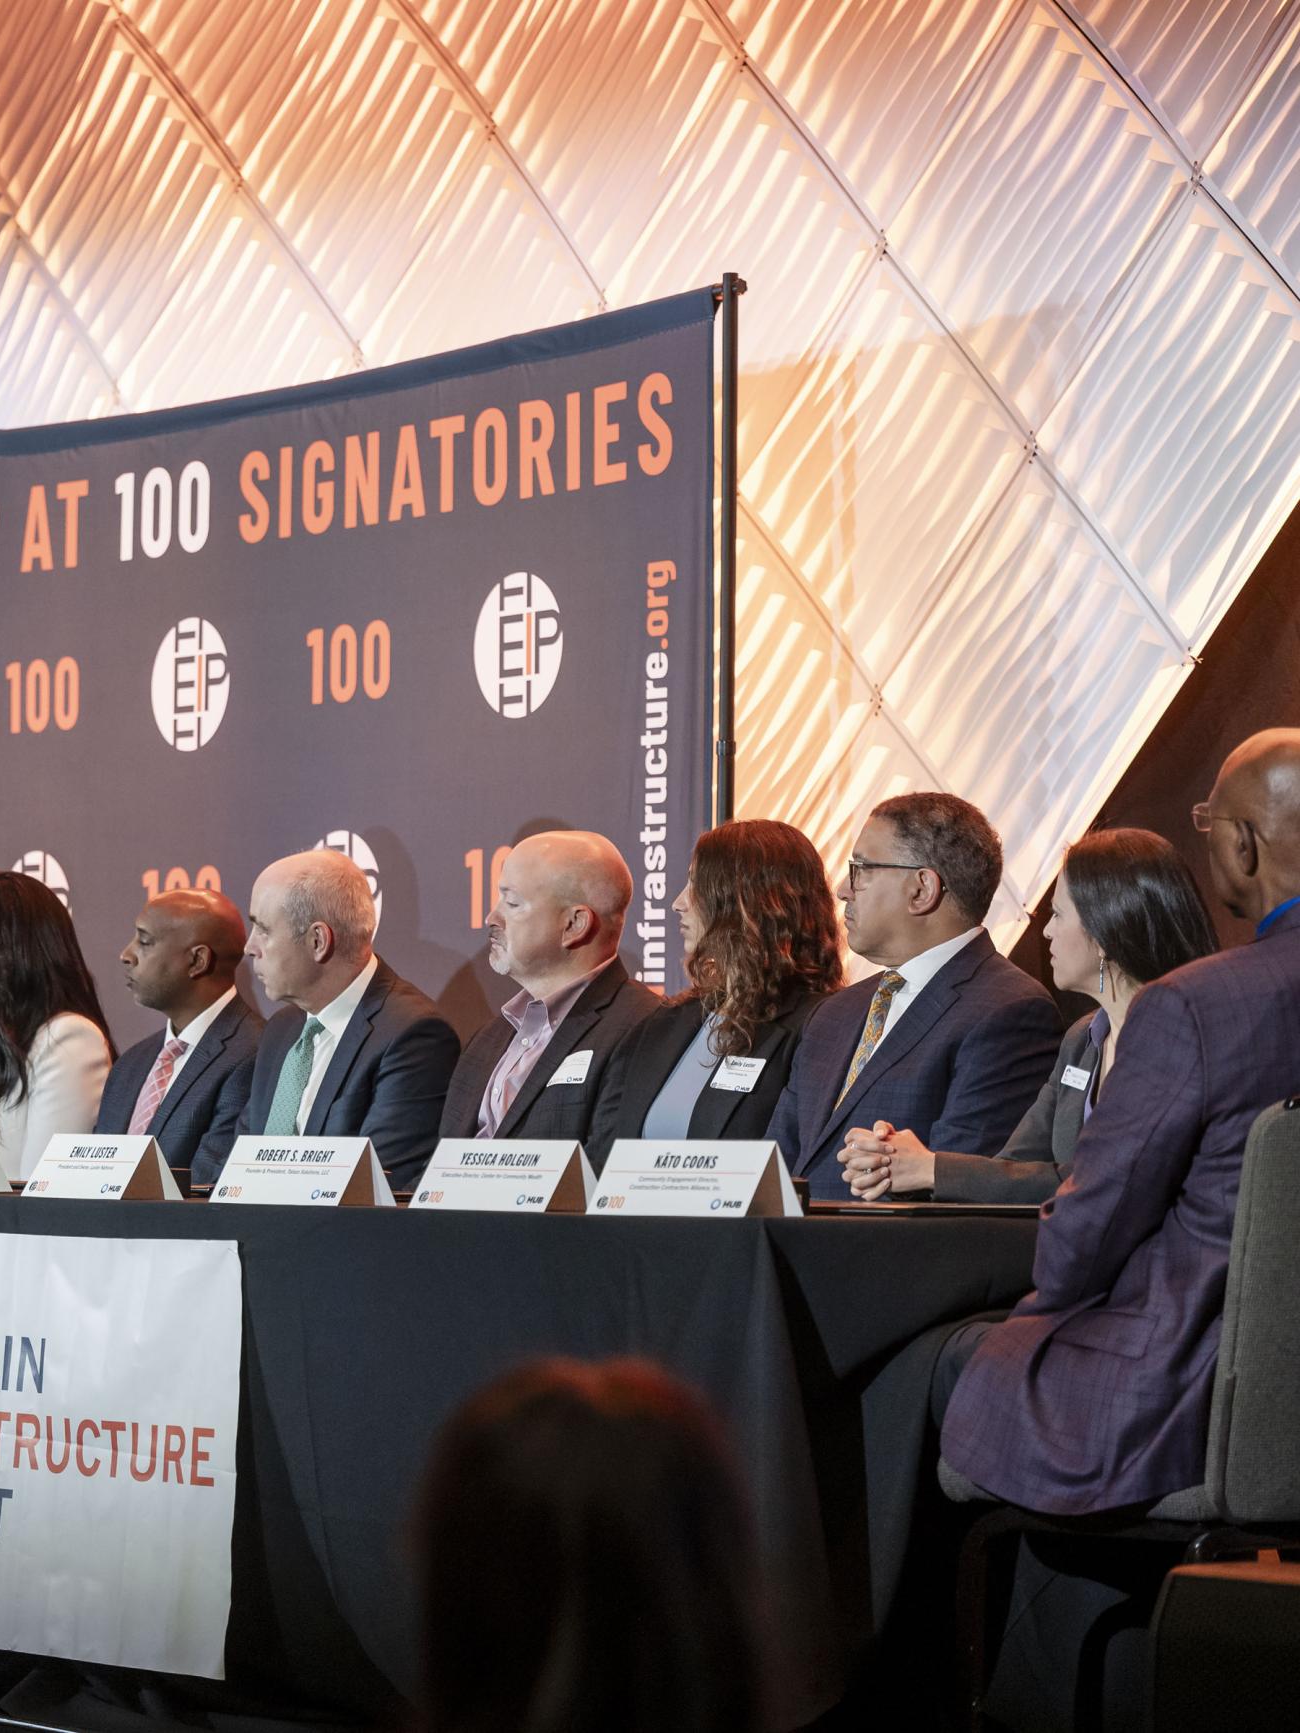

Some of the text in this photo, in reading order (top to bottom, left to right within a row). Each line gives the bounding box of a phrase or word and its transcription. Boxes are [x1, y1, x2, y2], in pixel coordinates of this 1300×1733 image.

[20, 480, 89, 573] AT
[115, 460, 211, 562] 100
[238, 372, 674, 545] SIGNATORIES
[306, 619, 391, 705] 100
[5, 655, 80, 734] 100
[70, 1146, 118, 1159] EMILY LUSTER
[255, 1149, 335, 1163] ROBERT S. BRIGHT
[460, 1152, 541, 1167] YESSICA HOLGUIN
[681, 1155, 719, 1169] COOKS
[227, 1186, 242, 1198] 100
[320, 1191, 337, 1199] HUB
[428, 1191, 444, 1203] 100
[526, 1196, 544, 1204] HUB
[607, 1196, 625, 1209] 100
[722, 1201, 742, 1209] HUB
[2, 1335, 46, 1394] IN
